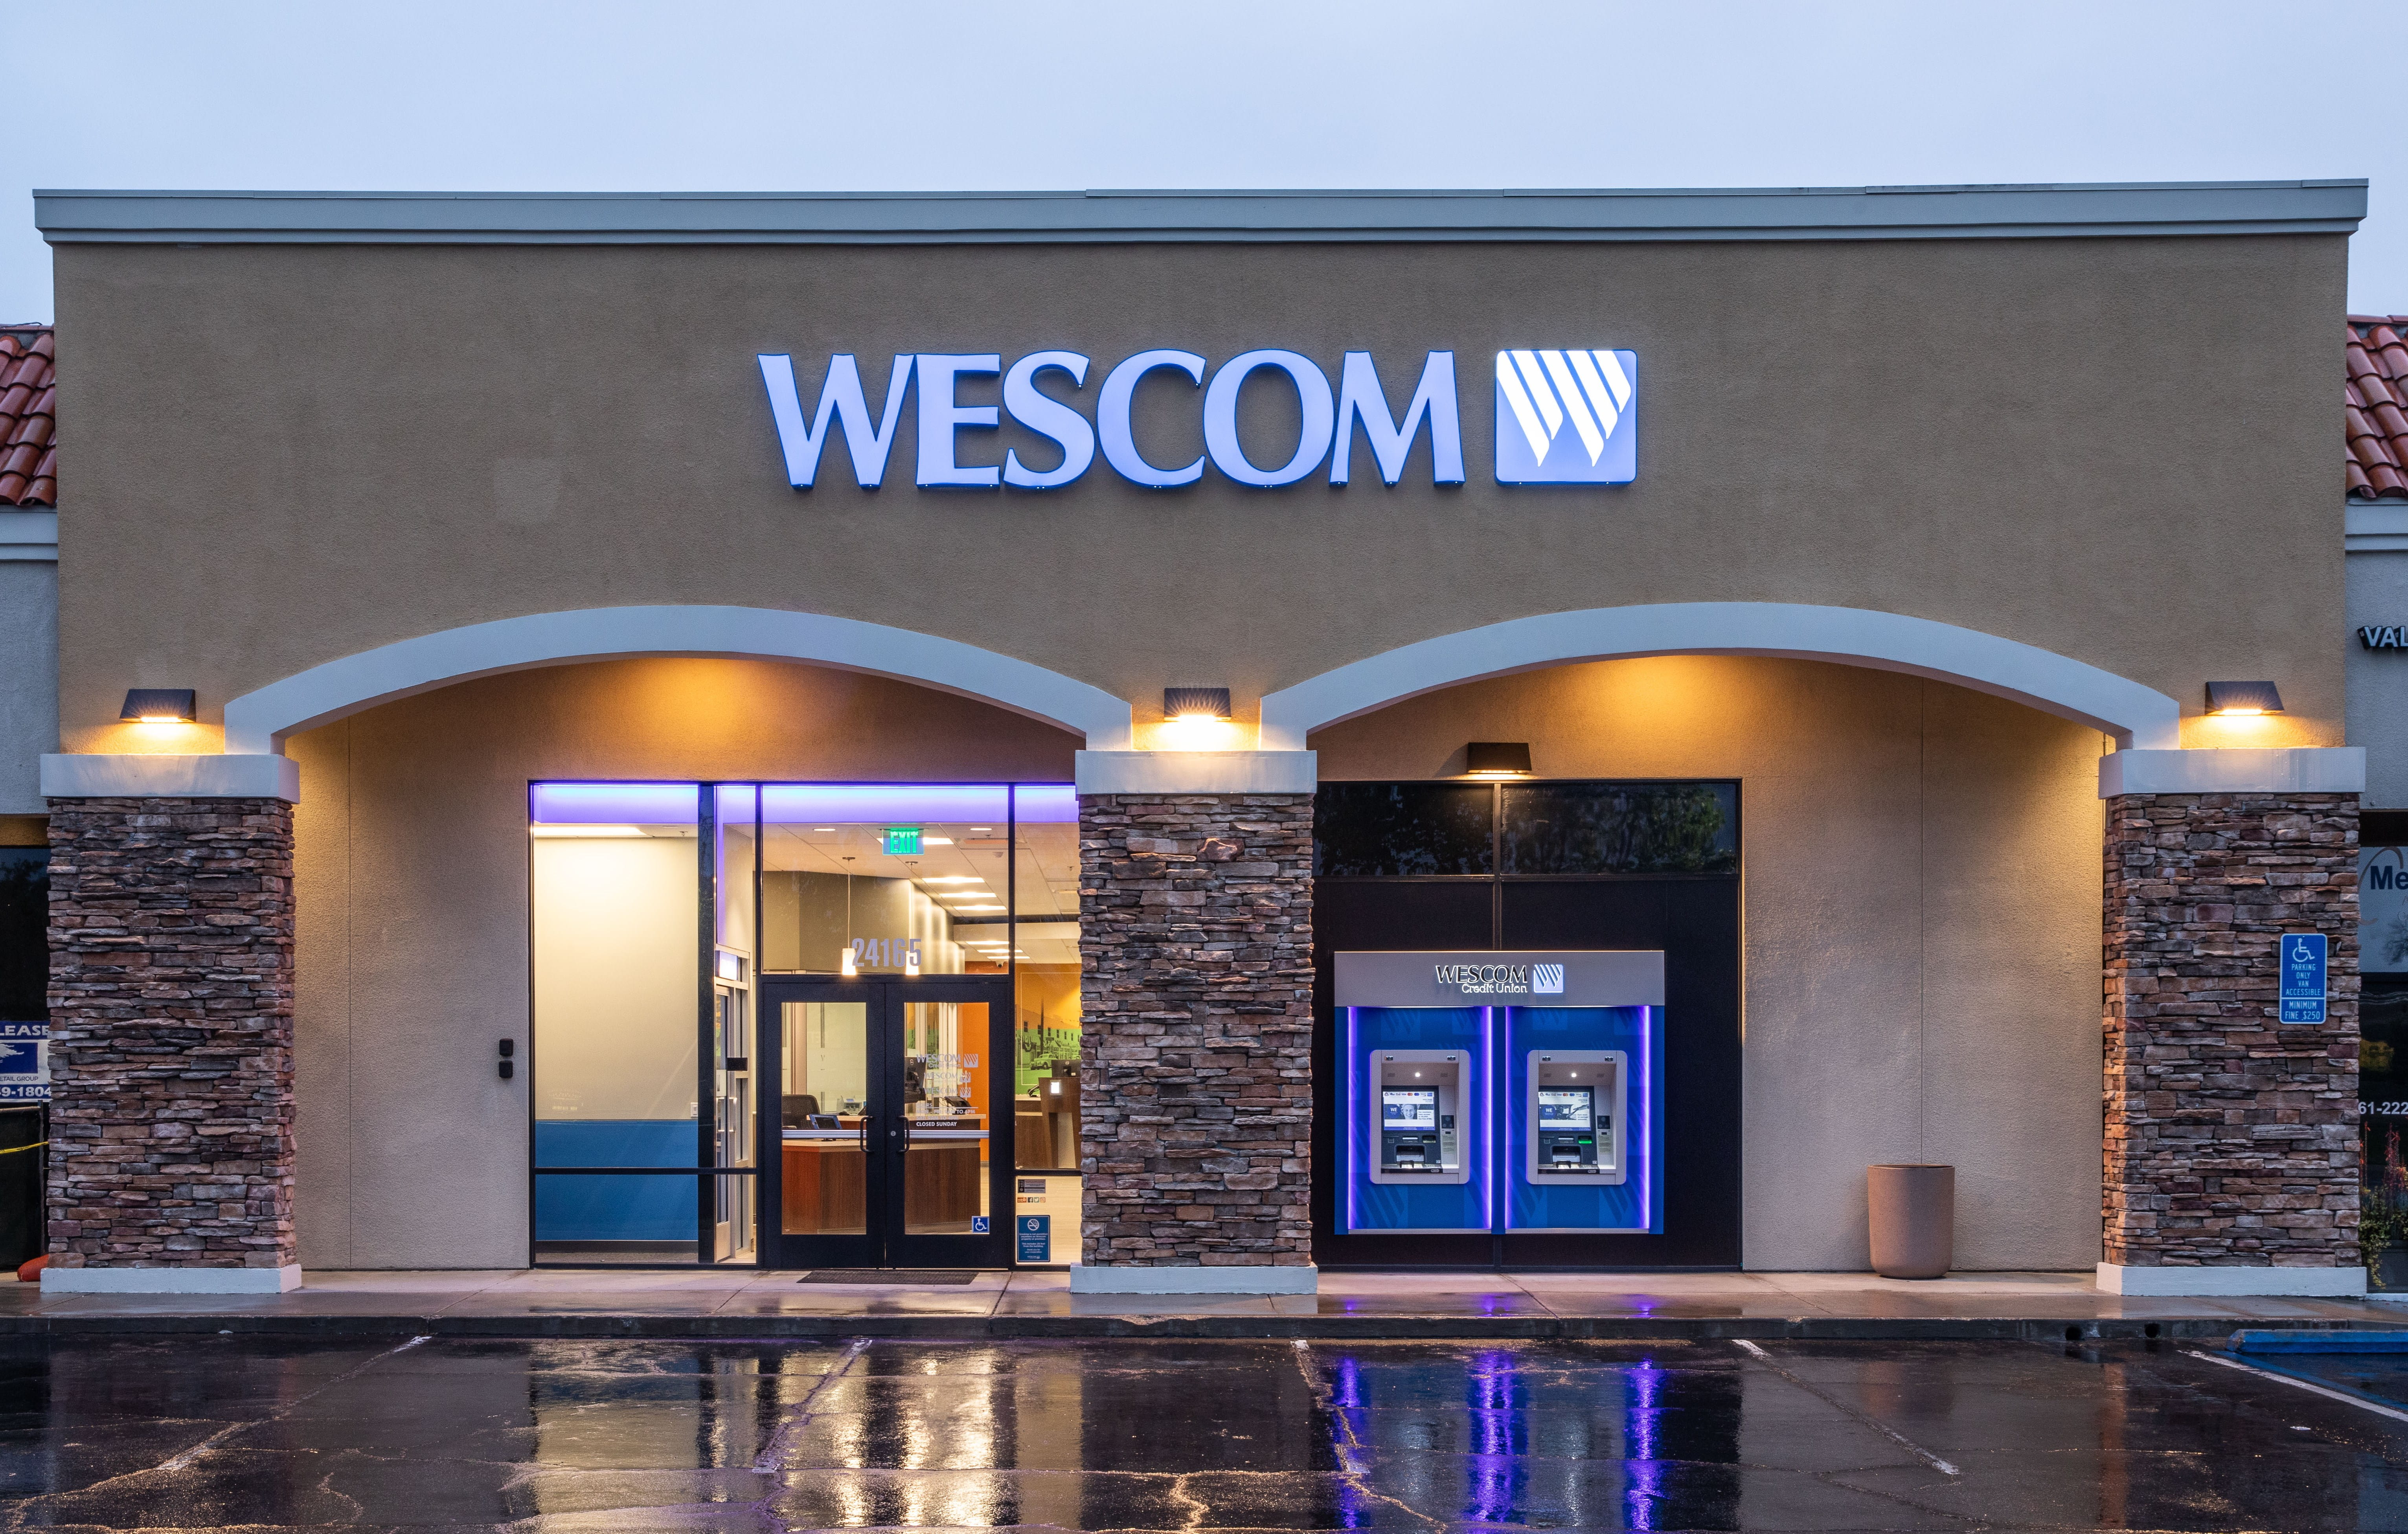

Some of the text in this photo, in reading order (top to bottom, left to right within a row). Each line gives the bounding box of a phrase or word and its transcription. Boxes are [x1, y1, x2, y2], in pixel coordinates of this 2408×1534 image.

[757, 349, 1466, 489] WESCOM
[2364, 626, 2408, 647] VAL
[890, 831, 918, 853] EXIT
[852, 938, 921, 966] 24165
[1436, 965, 1528, 983] WESCOM
[1462, 984, 1528, 993] Credit Union
[2303, 1011, 2320, 1020] $250
[916, 1054, 961, 1063] WESCOM
[0, 1087, 51, 1097] 9-1804
[2358, 1102, 2408, 1114] 61-222
